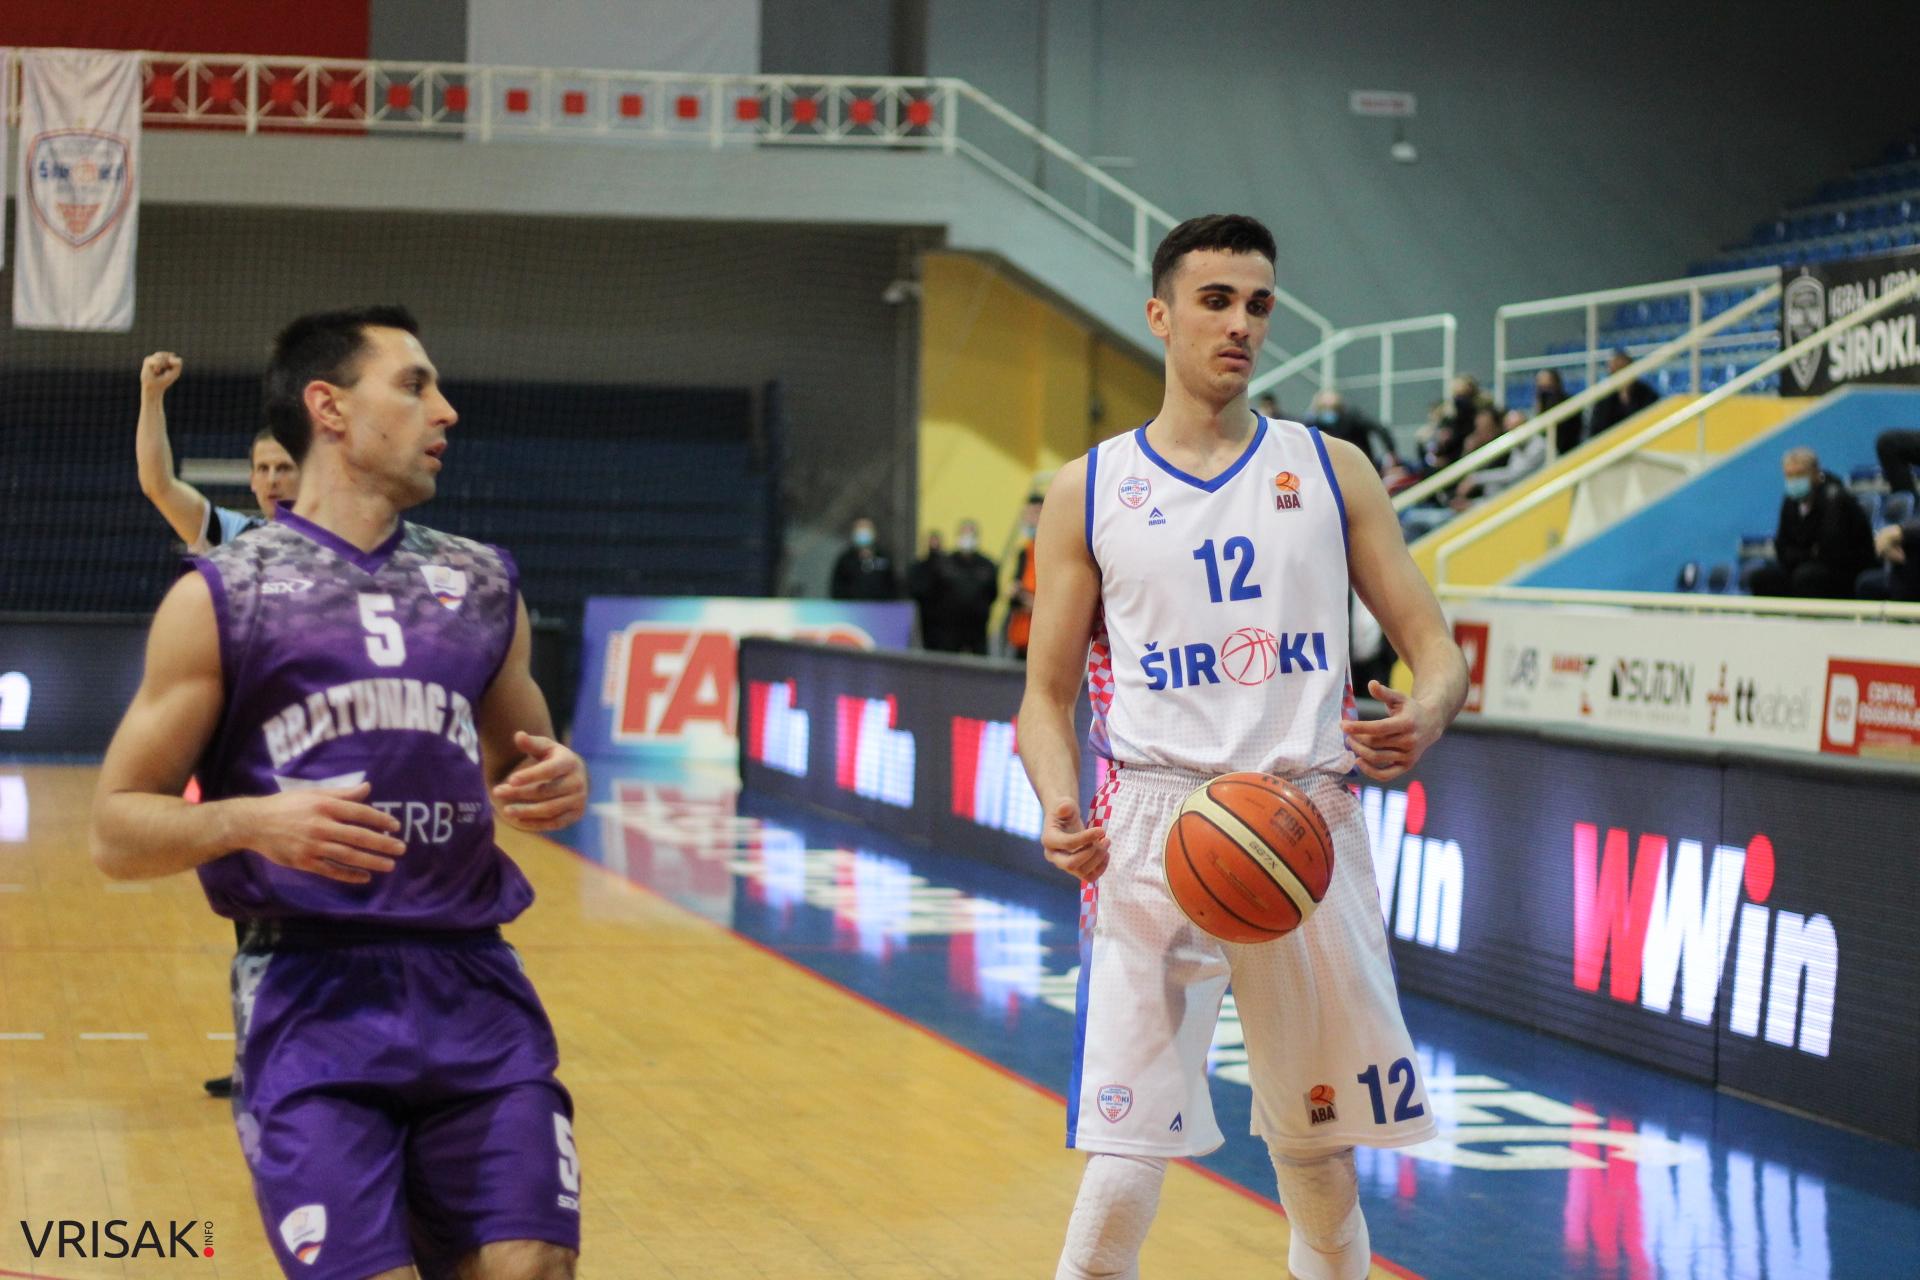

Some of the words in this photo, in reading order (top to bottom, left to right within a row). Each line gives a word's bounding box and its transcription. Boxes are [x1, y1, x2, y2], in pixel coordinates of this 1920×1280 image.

[1276, 494, 1301, 510] ABA
[1193, 535, 1262, 604] 12
[358, 592, 407, 667] 5
[1573, 821, 1839, 1058] WWin
[1311, 1106, 1336, 1125] ABA
[1357, 1057, 1425, 1125] 12
[553, 1111, 580, 1192] 5
